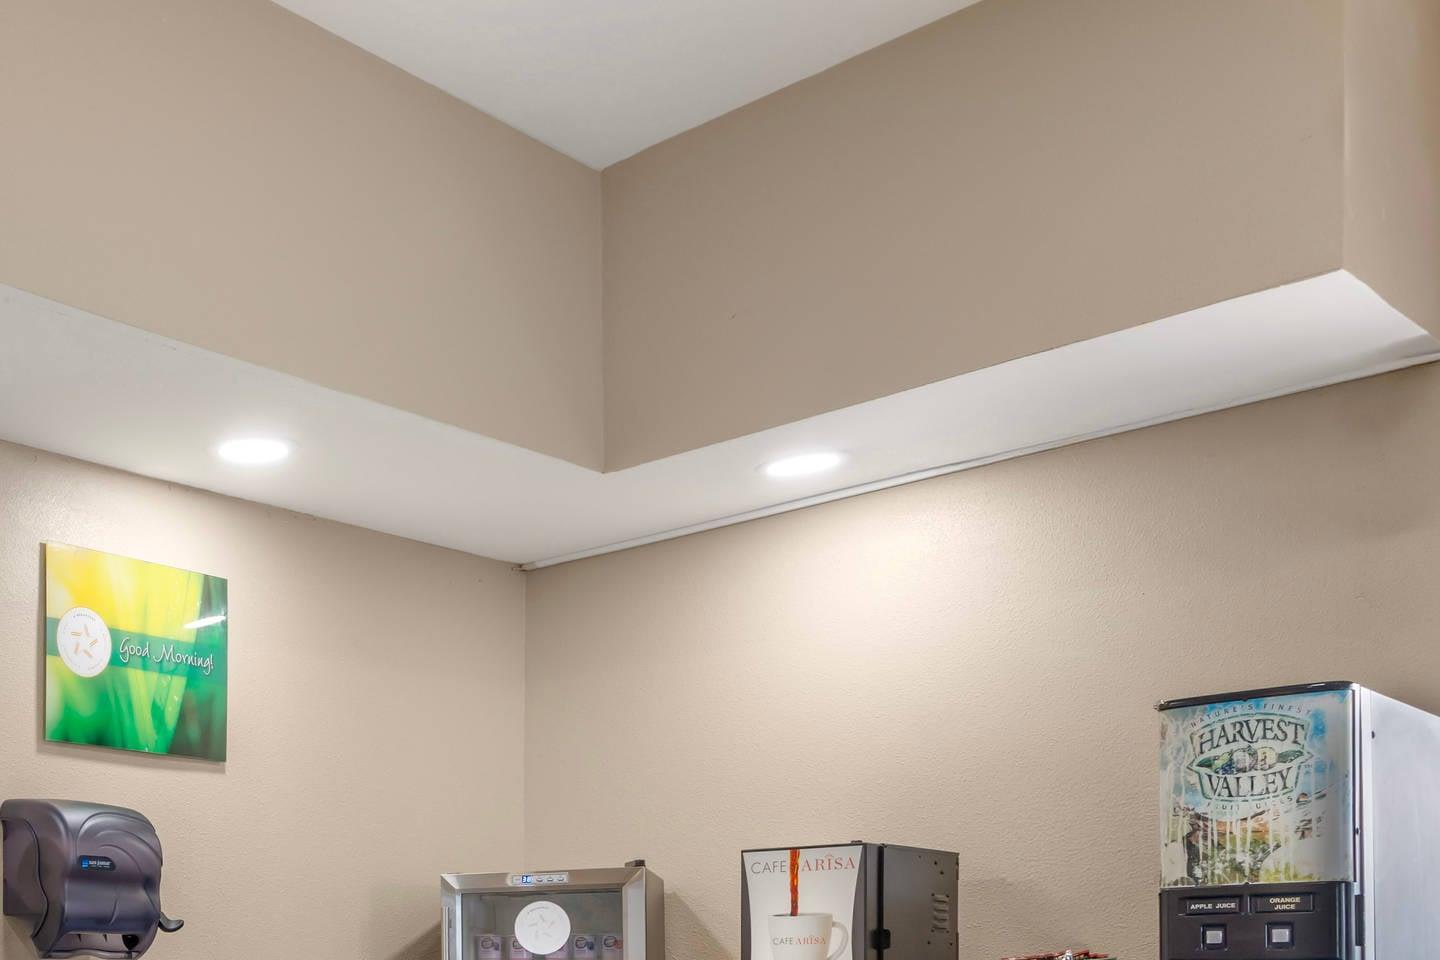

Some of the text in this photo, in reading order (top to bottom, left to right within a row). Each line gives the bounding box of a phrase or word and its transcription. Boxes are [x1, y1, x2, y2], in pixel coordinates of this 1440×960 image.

[119, 636, 214, 675] Good Morning!
[1198, 719, 1305, 755] HARVEST
[1206, 767, 1293, 798] VALLEY
[750, 860, 787, 874] CAFE
[772, 936, 794, 946] CAFE
